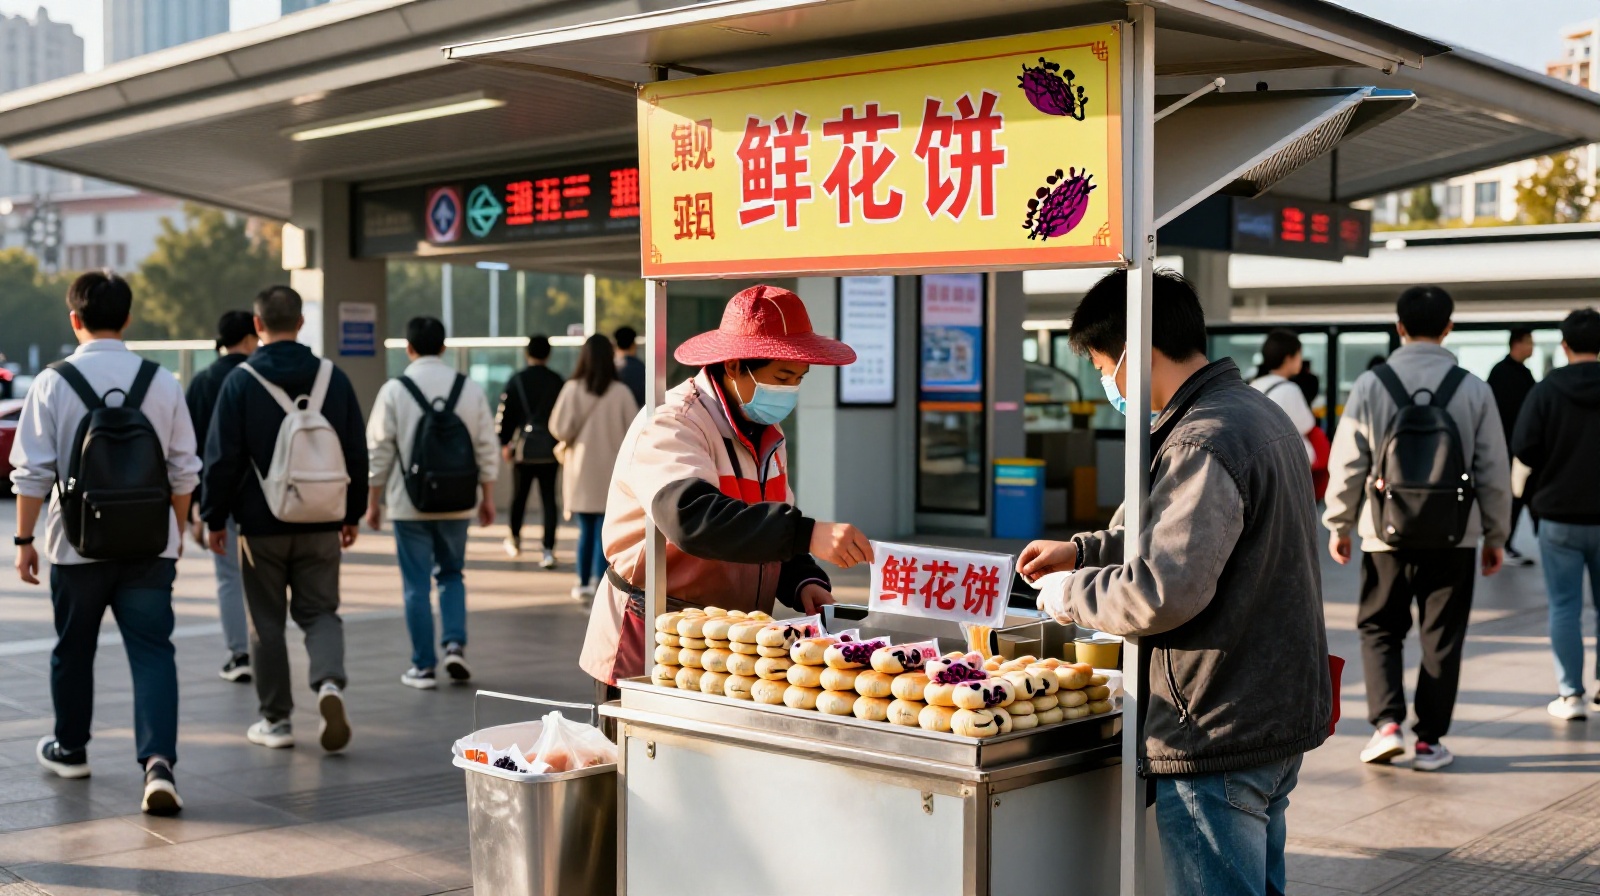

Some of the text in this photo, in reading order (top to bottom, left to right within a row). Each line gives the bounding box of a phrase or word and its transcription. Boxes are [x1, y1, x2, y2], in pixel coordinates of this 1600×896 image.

[736, 90, 1005, 229] 鲜花饼
[879, 554, 1000, 617] 鲜花饼
